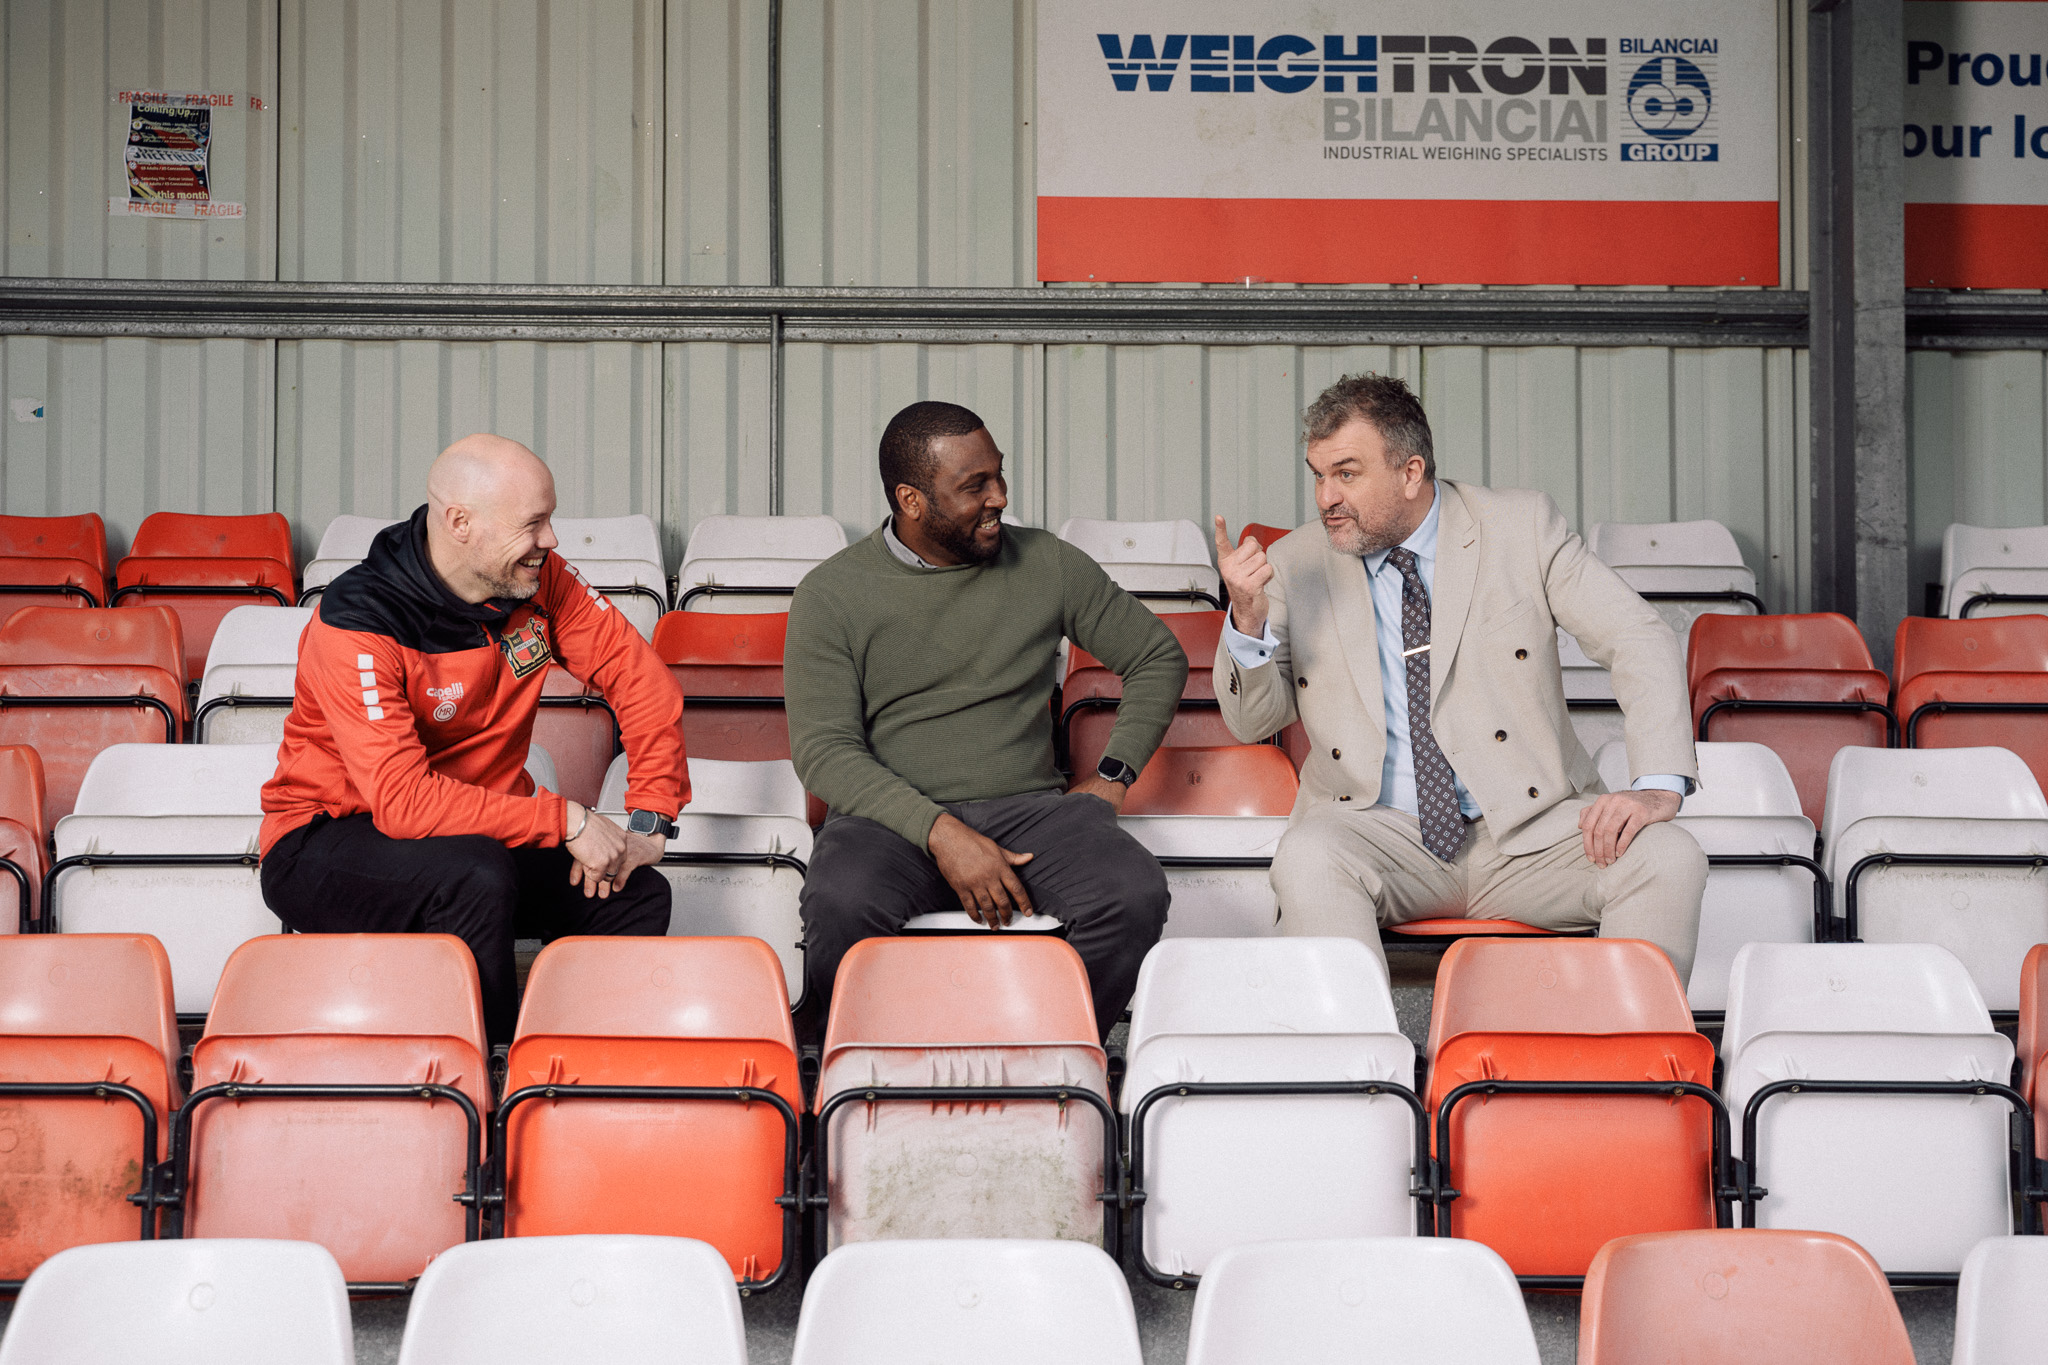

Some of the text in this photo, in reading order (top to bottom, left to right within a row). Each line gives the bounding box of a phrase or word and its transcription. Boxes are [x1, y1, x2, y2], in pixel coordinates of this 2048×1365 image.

[1619, 38, 1718, 54] BILANCIAI
[1096, 33, 1607, 95] WEIGHTRON
[1907, 41, 2048, 87] Prou
[119, 91, 168, 104] FRAGILE
[185, 94, 233, 106] FRAGILE
[138, 105, 174, 117] Coming
[1323, 97, 1607, 143] BILANCIAI
[1323, 146, 1608, 161] INDUSTRIAL WEIGHING SPECIALISTS
[1628, 144, 1711, 161] GROUP
[177, 191, 209, 200] month
[128, 201, 243, 216] FRAGILE FRAGILE
[426, 682, 464, 700] capelli
[438, 707, 452, 716] MR
